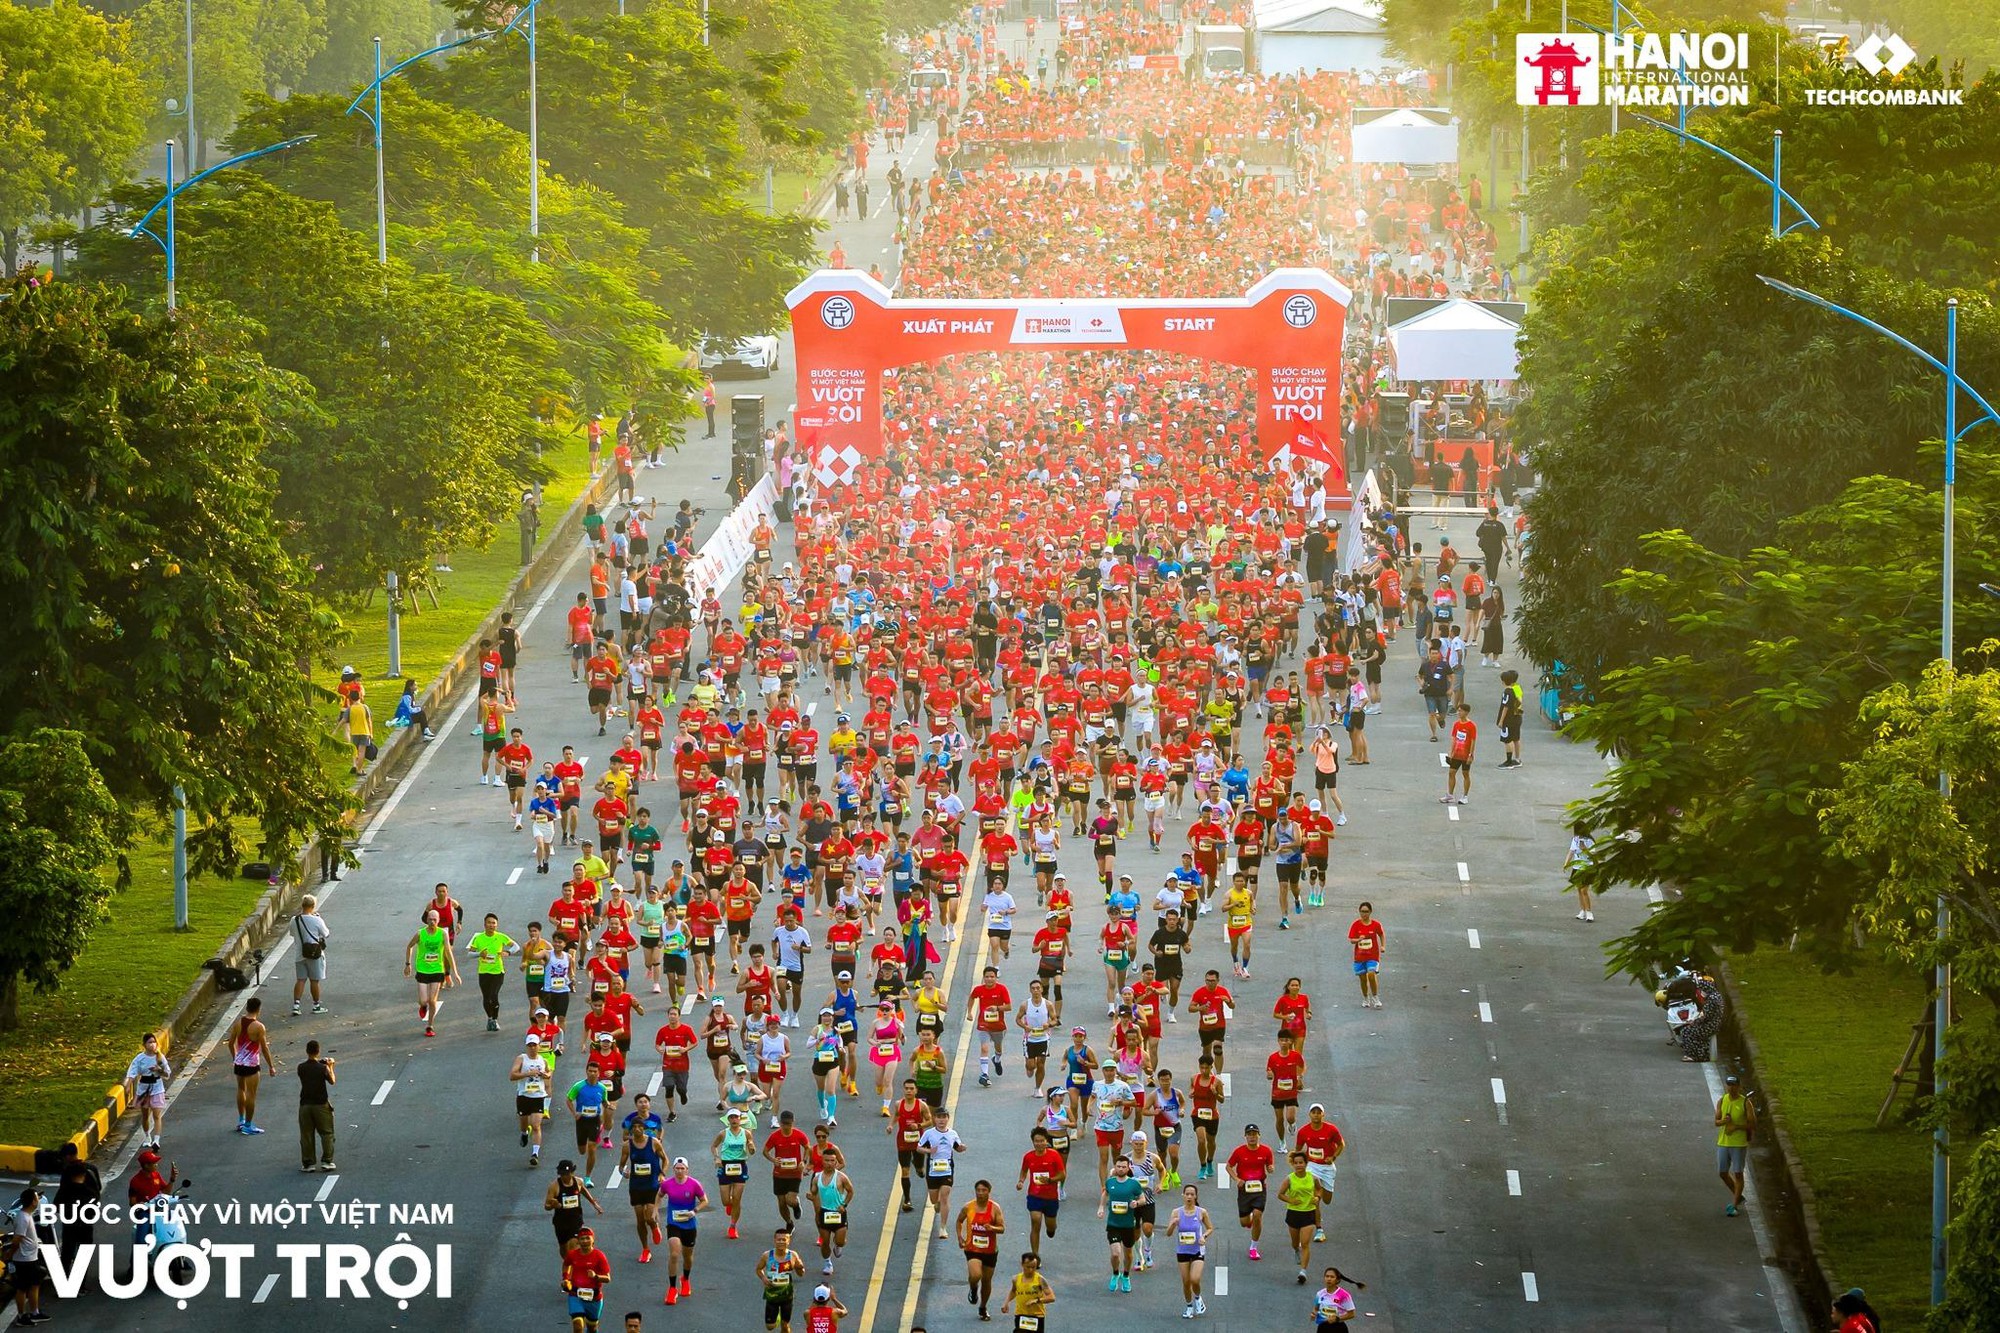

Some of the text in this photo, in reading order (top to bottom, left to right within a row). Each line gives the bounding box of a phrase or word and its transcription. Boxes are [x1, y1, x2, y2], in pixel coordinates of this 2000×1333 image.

[903, 318, 994, 334] XUẤT PHÁT
[1042, 318, 1071, 326] HANOI
[1164, 318, 1216, 331] START
